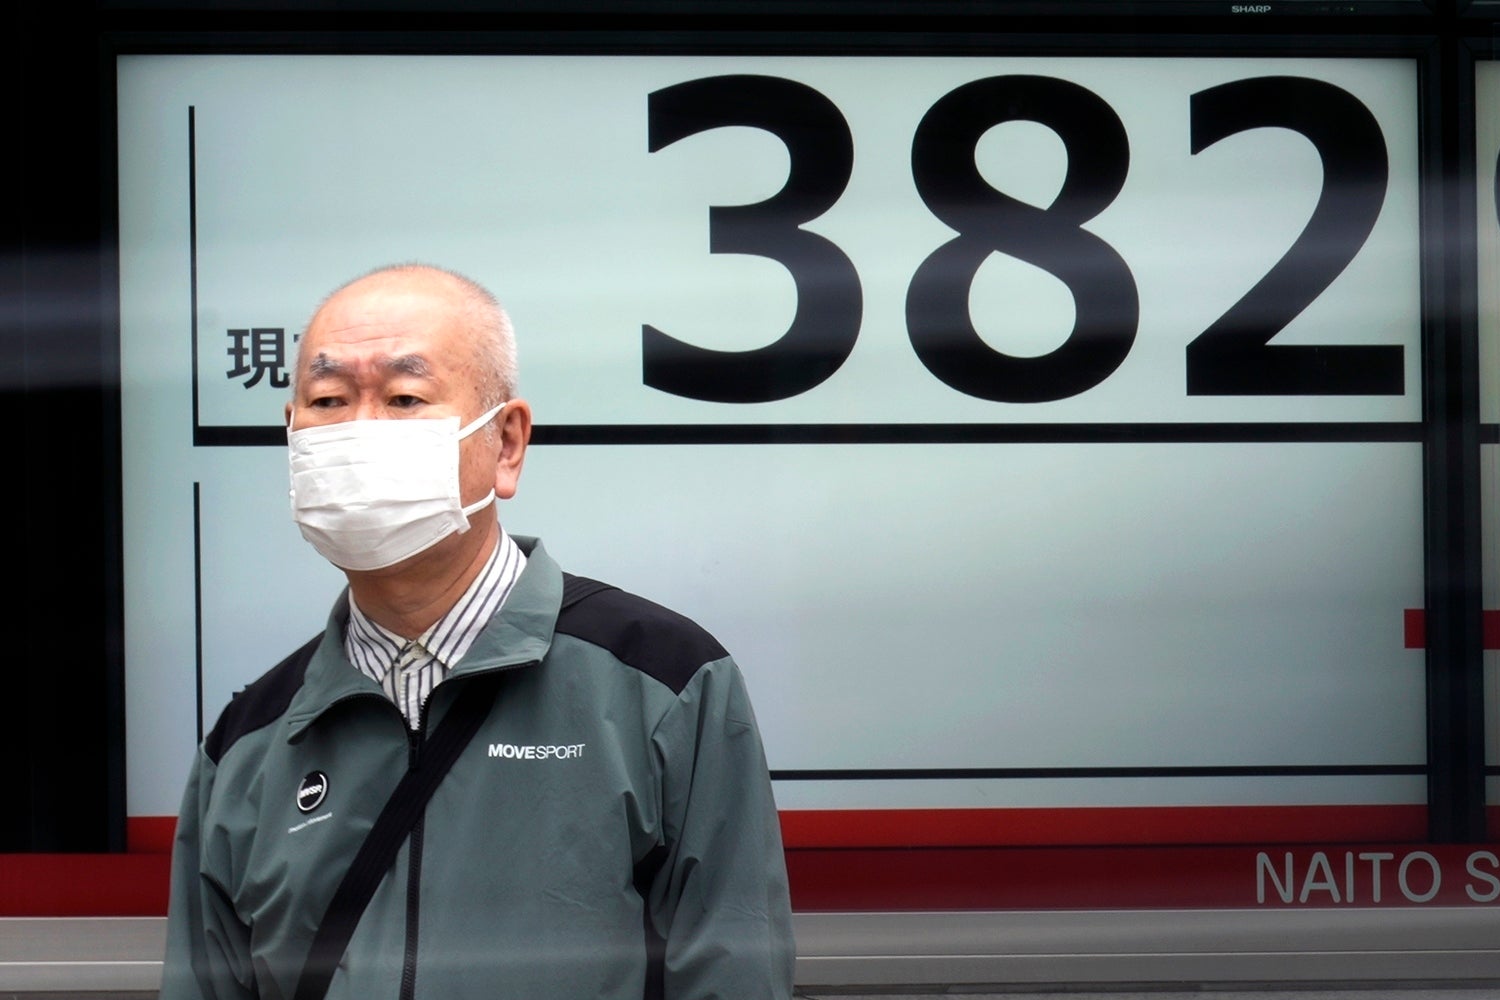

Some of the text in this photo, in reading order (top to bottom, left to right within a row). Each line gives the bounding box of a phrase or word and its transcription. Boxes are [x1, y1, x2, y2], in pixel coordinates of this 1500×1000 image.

[1231, 4, 1272, 14] SHARP
[226, 327, 300, 390] 現
[487, 743, 586, 760] MOVESPORT
[1255, 850, 1442, 904] NAITO
